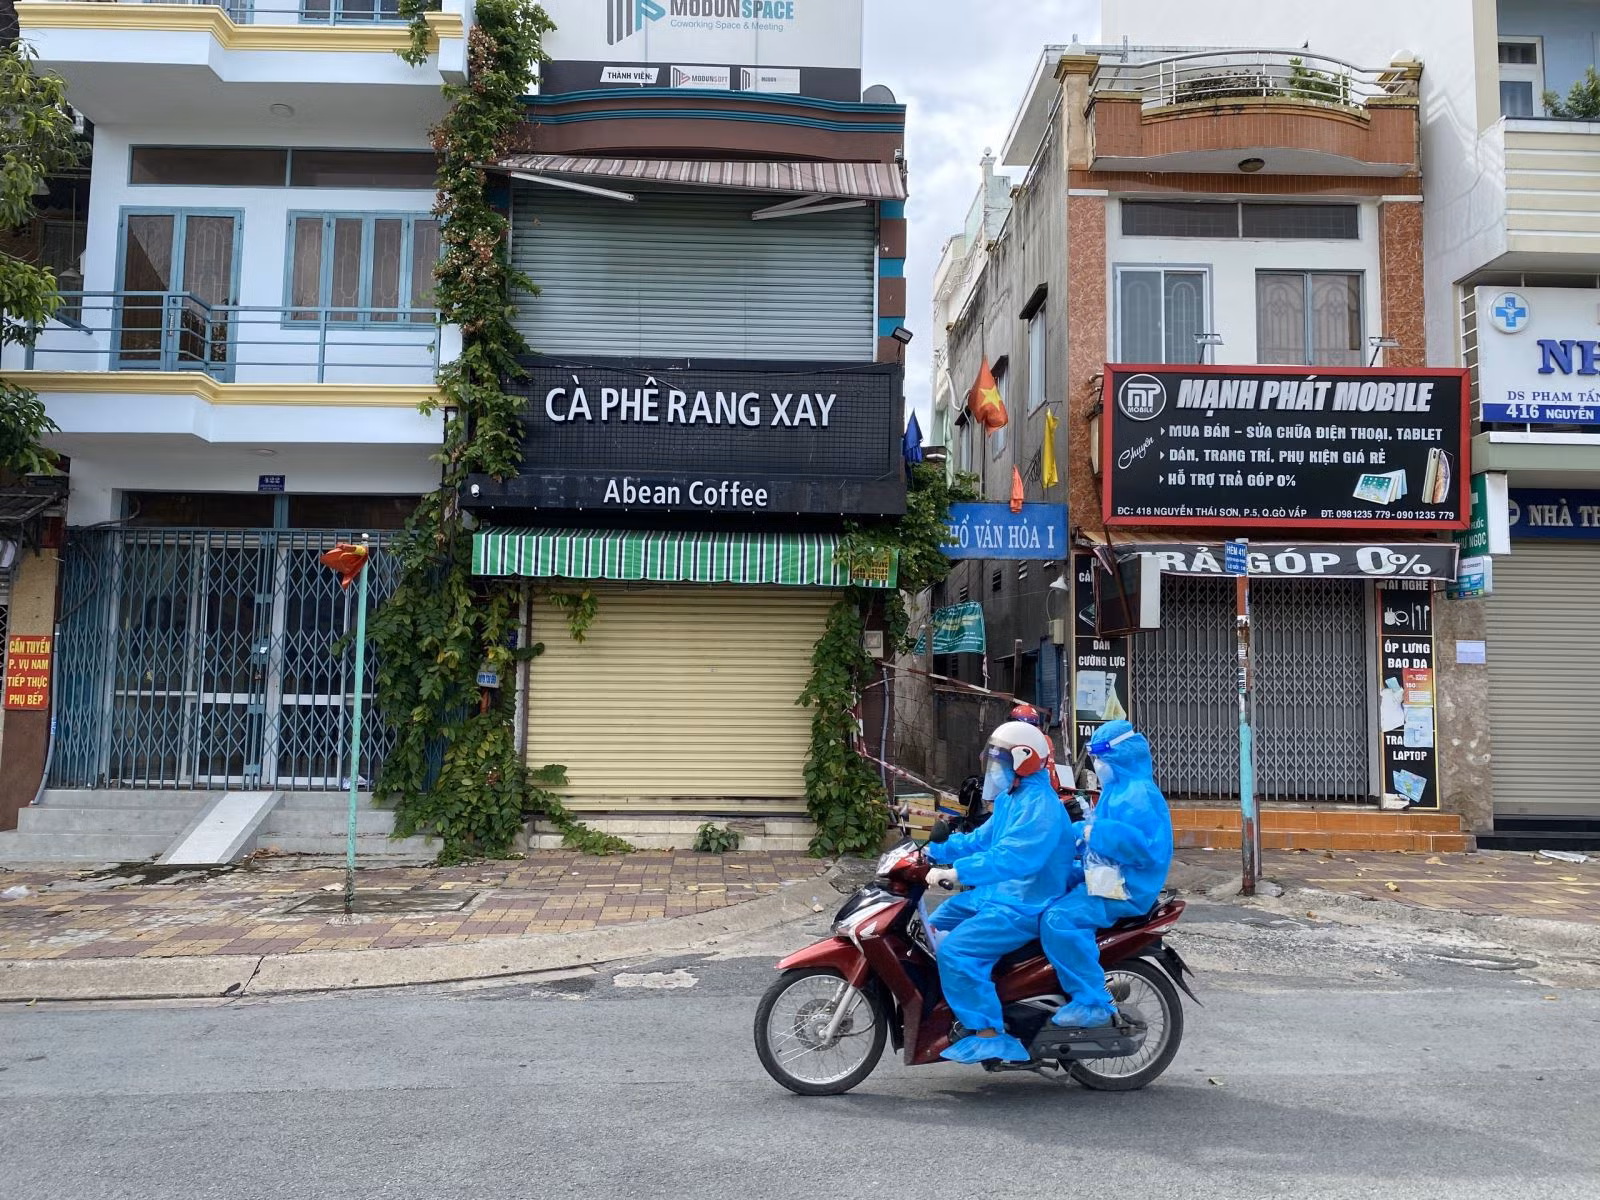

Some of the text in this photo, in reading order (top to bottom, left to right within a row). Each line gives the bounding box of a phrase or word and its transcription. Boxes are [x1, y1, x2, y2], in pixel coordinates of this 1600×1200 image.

[670, 0, 794, 19] MODUNSPACE
[670, 19, 784, 32] Coworking Space & Meeting
[608, 71, 632, 80] THÀNH
[691, 75, 728, 83] MODUNSOFT
[545, 375, 837, 427] CÀ PHÊ RANG XAY
[1176, 375, 1434, 417] MẠNH PHÁT MOBILE
[1507, 391, 1525, 401] DS
[1532, 391, 1572, 404] PHẠM
[1506, 404, 1595, 420] 416 NGUYỄN
[1169, 425, 1200, 438] MUA
[1203, 423, 1230, 438] BÁN
[1246, 422, 1273, 439] SỬA
[1276, 424, 1311, 439] CHỮA
[1316, 425, 1346, 441] ĐIỆN
[1350, 428, 1393, 442] THOẠI,
[1396, 428, 1443, 441] TABLET
[1118, 437, 1154, 469] Chuyên
[1169, 447, 1386, 466] DÁN, TRANG TRÍ, PHỤ KIỆN GIÁ RẺ
[1168, 469, 1297, 489] HỖ TRỢ TRẢ GÓP 0%
[603, 479, 768, 507] Abean Coffee
[1117, 506, 1134, 515] ĐC:
[1136, 506, 1152, 515] 418
[1153, 504, 1193, 516] NGUYỄN
[1195, 506, 1217, 516] THÁI
[1219, 507, 1241, 517] SƠN,
[1288, 505, 1307, 518] VẤP
[1320, 509, 1334, 519] ĐT:
[1438, 511, 1455, 520] 779
[1528, 498, 1574, 527] NHÀ
[974, 519, 1003, 549] VĂN
[1469, 532, 1487, 549] NGỌC
[1141, 546, 1432, 575] RẢ GÓP 0%
[1401, 580, 1429, 591] NGHE
[26, 636, 51, 654] TUYỂN
[1384, 638, 1431, 653] ỐP LƯNG
[8, 659, 49, 672] P. VỤ NAM
[1078, 654, 1126, 669] CƯỜNG LỰC
[1387, 657, 1428, 669] BAO DA
[7, 672, 48, 688] TIẾP THỰC
[9, 691, 44, 707] PHỤ BẾP
[1393, 750, 1428, 761] LAPTOP
